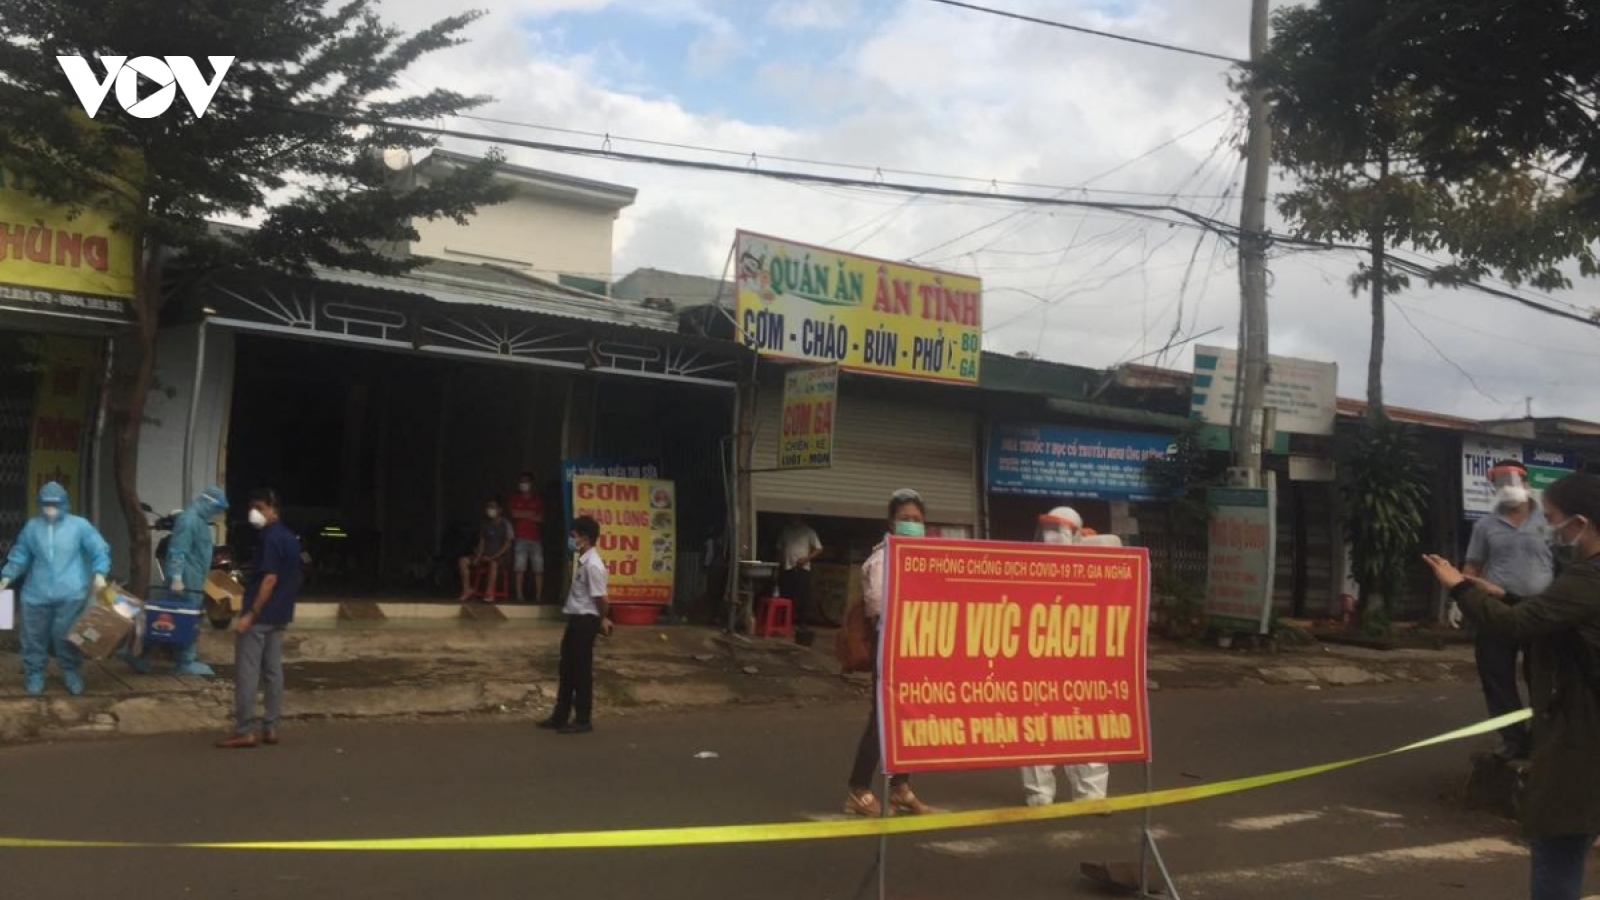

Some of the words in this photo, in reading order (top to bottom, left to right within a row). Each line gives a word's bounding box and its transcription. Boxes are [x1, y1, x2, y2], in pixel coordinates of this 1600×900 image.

[769, 253, 830, 297] QUÁN
[834, 262, 864, 303] ĂN
[872, 265, 912, 316] ÂN
[917, 275, 980, 327] TÌNH
[743, 309, 784, 352] CƠM
[802, 317, 848, 361] CHÁO
[864, 324, 898, 368] BÚN
[912, 328, 945, 373] PHỞ
[577, 482, 640, 502] CƠM
[599, 531, 640, 552] ÚN
[605, 555, 639, 576] HỞ
[904, 556, 927, 574] BCĐ
[929, 555, 965, 575] PHÒNG
[968, 554, 1002, 577] CHỐNG
[1004, 561, 1028, 580] DỊCH
[1029, 562, 1071, 579] COVID-19
[1073, 564, 1086, 579] TP.
[1087, 564, 1102, 580] GIA
[1104, 564, 1132, 581] NGHĨA
[900, 601, 958, 658] KHU
[965, 595, 1021, 668] VỰC
[1027, 595, 1098, 658] CÁCH
[1105, 605, 1132, 658] LY
[899, 677, 956, 704] PHÒNG
[961, 673, 1017, 704] CHỐNG
[1023, 681, 1059, 707] DỊCH
[1063, 681, 1129, 702] COVID-19
[901, 714, 965, 747] KHÔNG
[971, 713, 1019, 748] PHẬN
[1023, 713, 1049, 747] SỰ
[1051, 707, 1094, 742] MIỄN
[1098, 710, 1132, 740] VÀO
